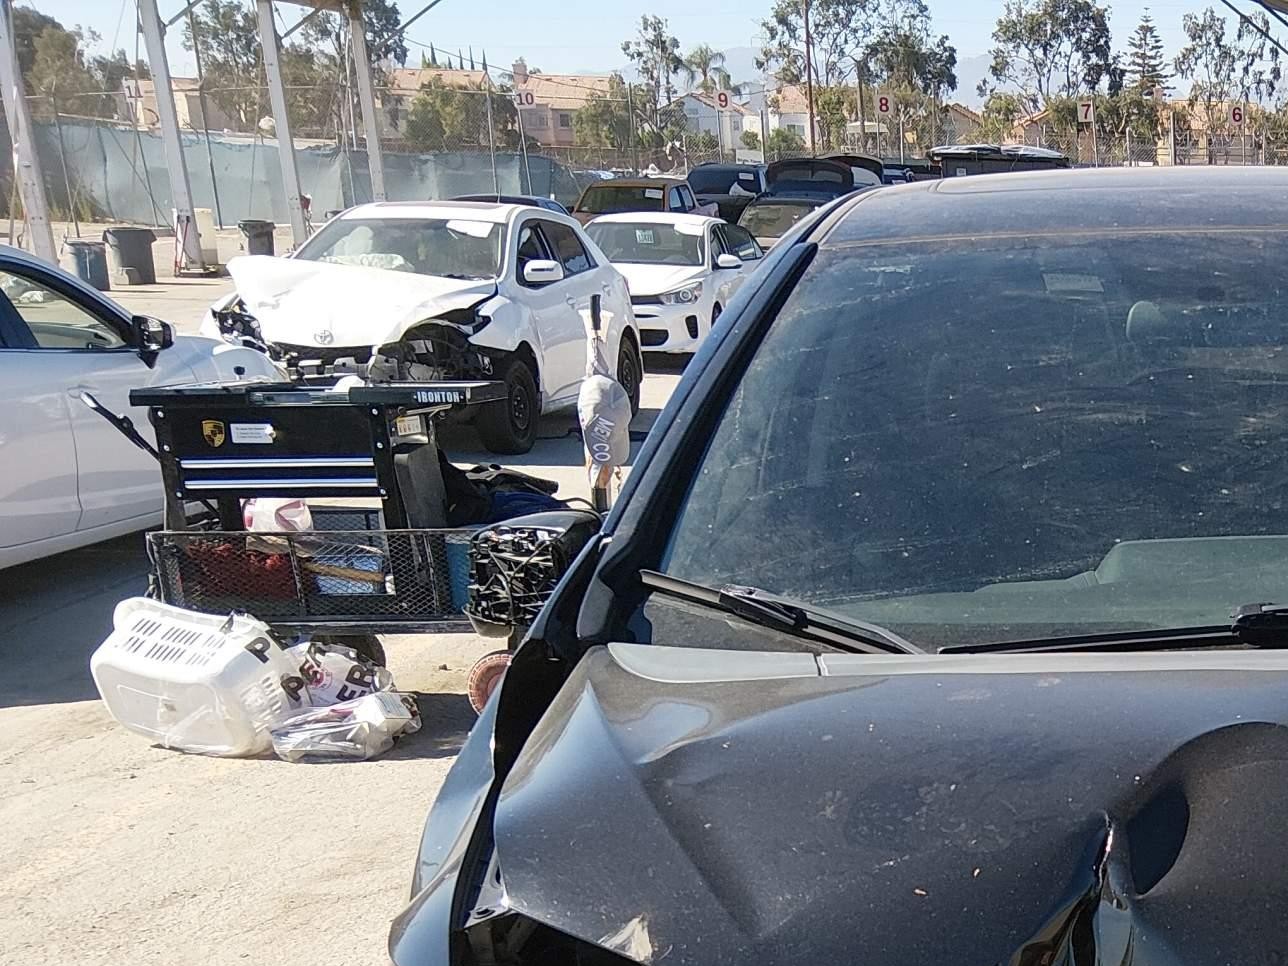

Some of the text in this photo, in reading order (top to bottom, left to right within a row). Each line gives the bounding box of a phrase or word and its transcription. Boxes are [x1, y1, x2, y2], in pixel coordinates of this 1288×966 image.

[516, 93, 534, 105] 10
[718, 92, 728, 108] 9
[879, 97, 889, 112] 8
[1081, 104, 1091, 119] 7
[1232, 107, 1243, 122] 6
[416, 391, 460, 403] IRONTON
